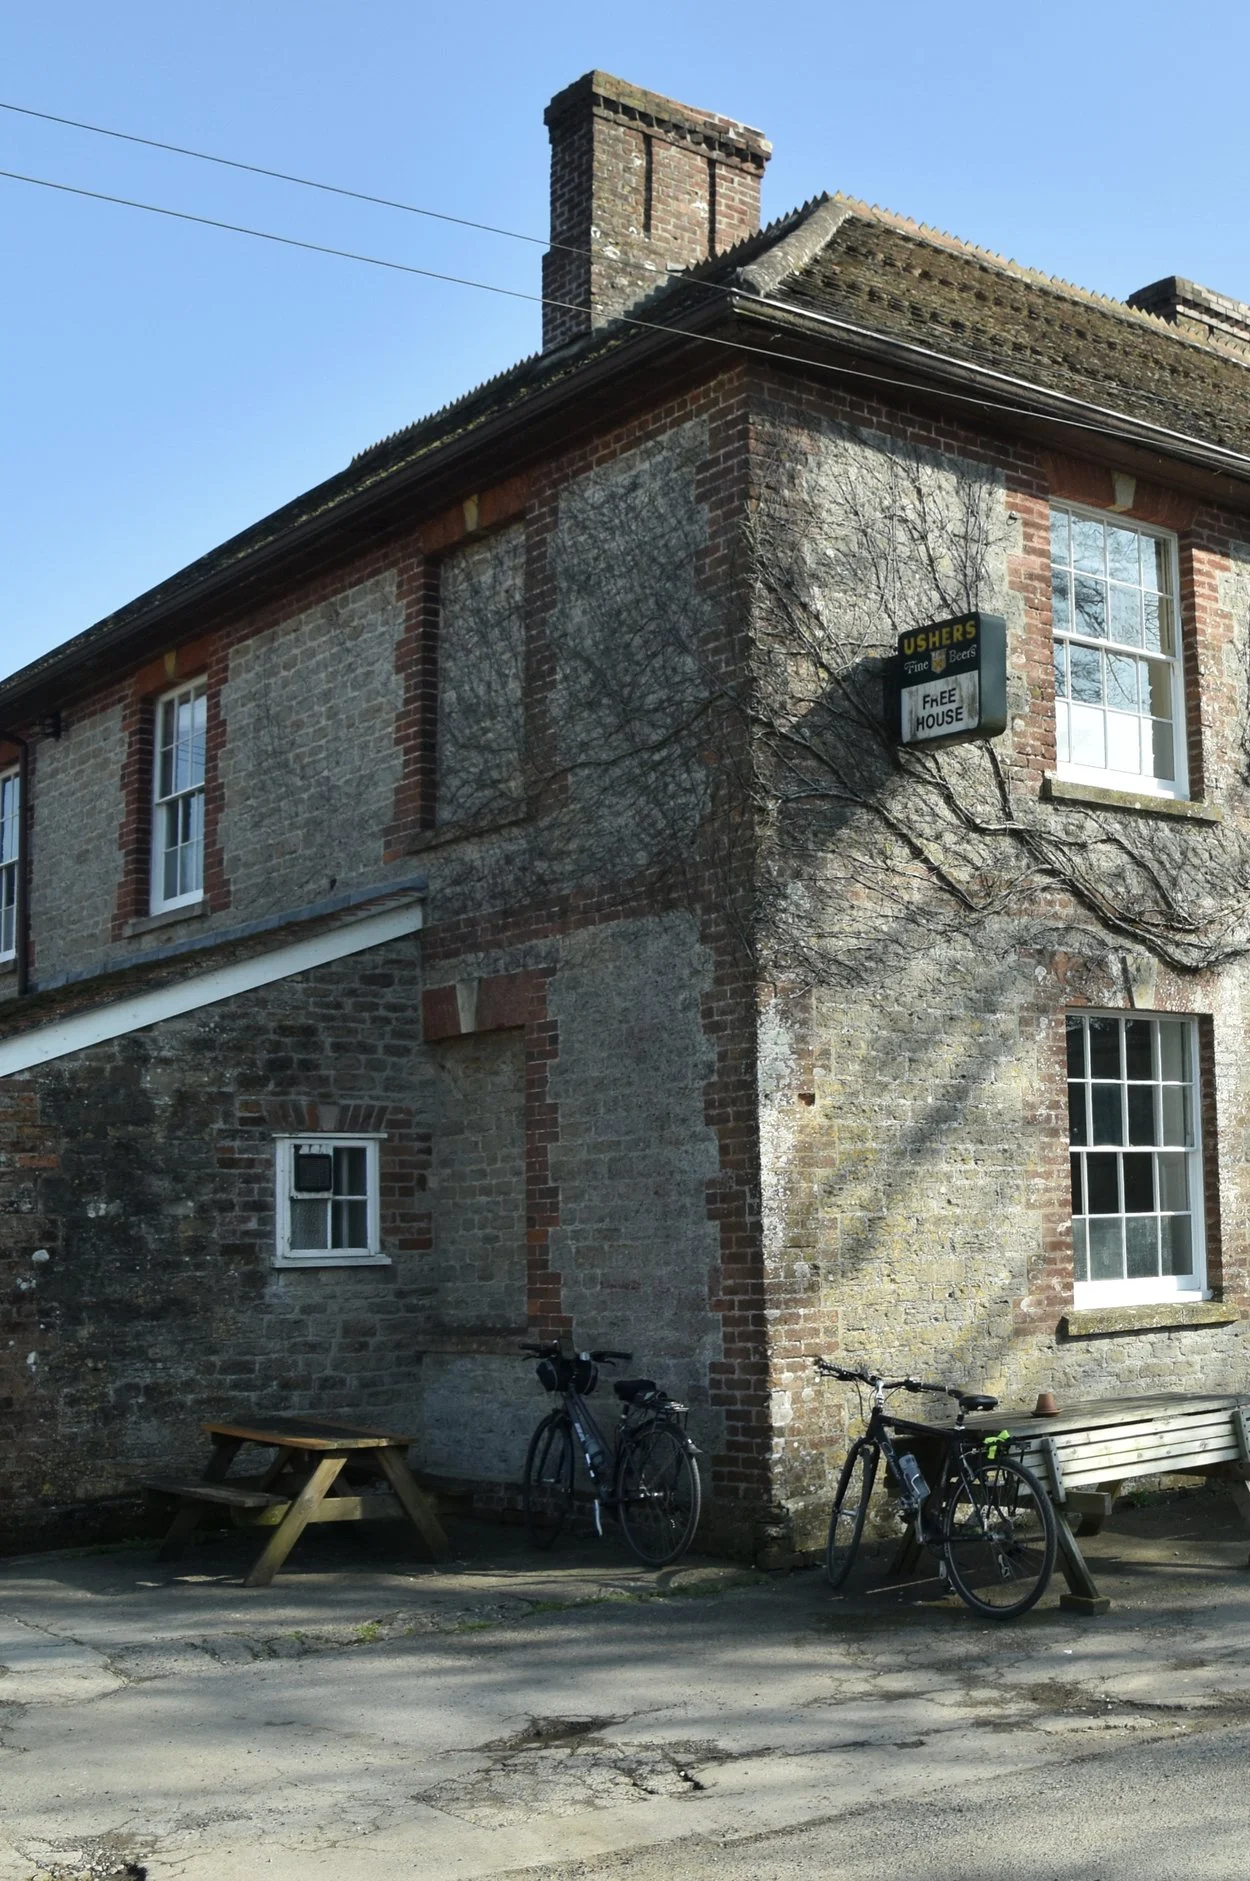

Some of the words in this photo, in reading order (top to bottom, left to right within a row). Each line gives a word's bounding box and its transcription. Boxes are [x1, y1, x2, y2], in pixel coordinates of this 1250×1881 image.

[904, 621, 976, 655] USHERS
[904, 660, 929, 674] Fine
[949, 645, 977, 663] Beers
[923, 688, 956, 710] FREE
[916, 707, 963, 732] HOUSE
